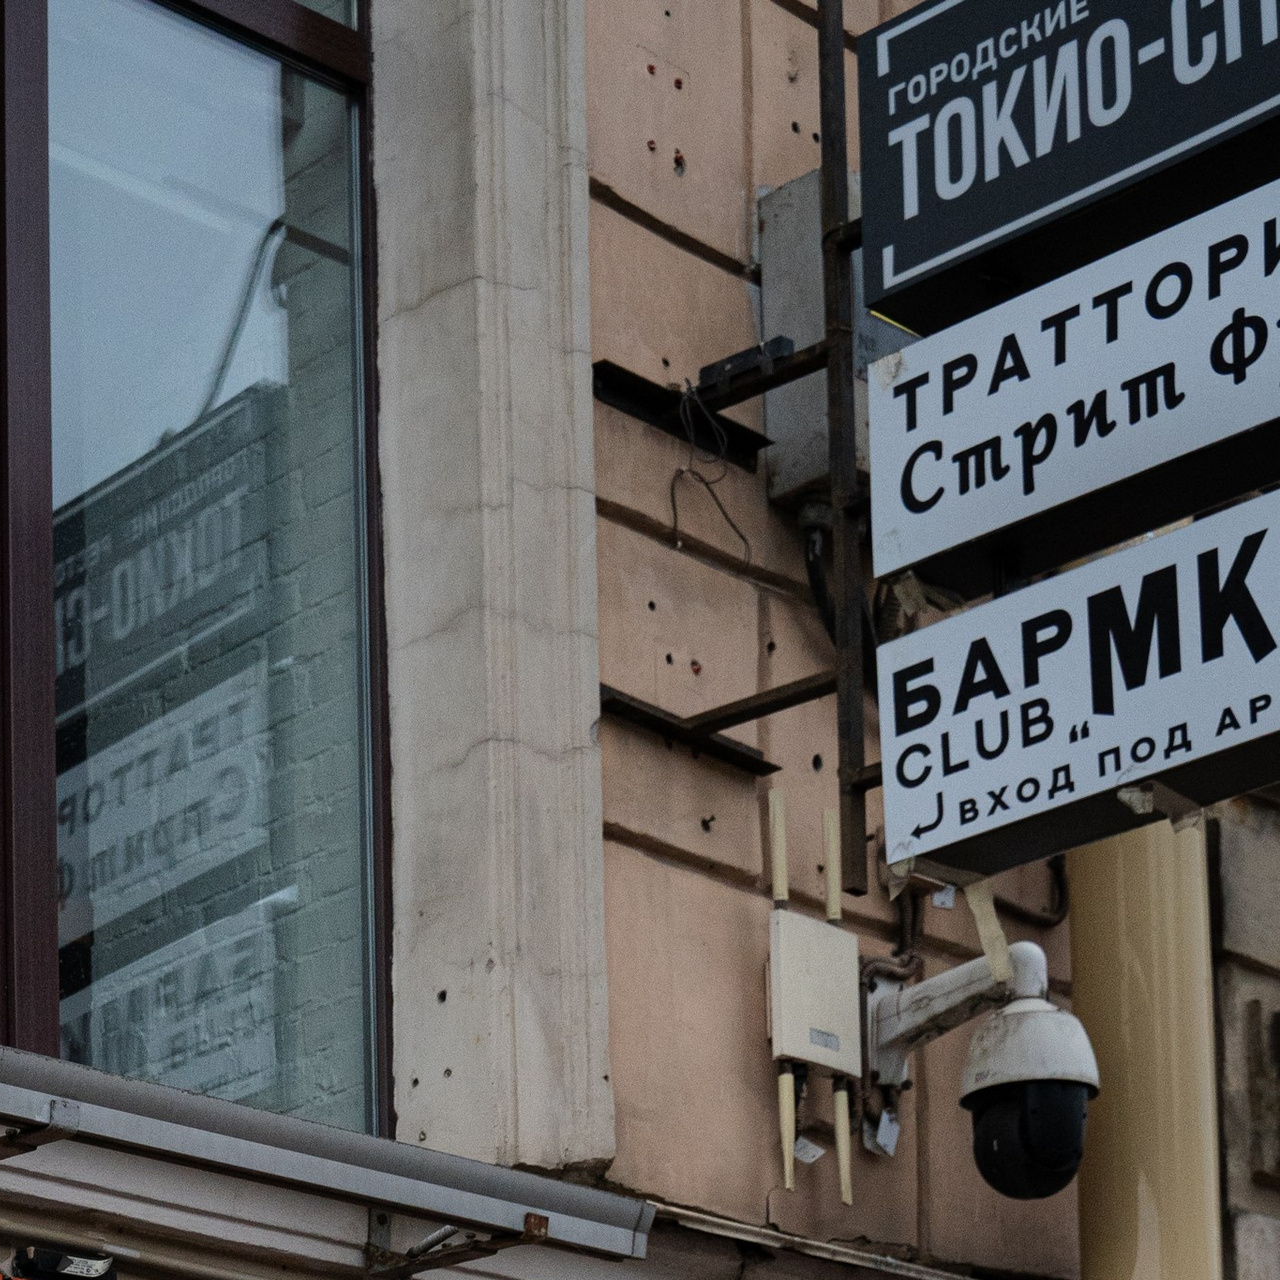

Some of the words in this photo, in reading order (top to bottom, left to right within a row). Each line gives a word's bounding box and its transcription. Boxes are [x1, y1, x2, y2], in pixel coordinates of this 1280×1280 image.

[888, 0, 1090, 116] ГОРОДСКИЕ
[899, 361, 1186, 515] Стрит
[1209, 306, 1280, 387] Ф
[892, 608, 1073, 738] БАР
[896, 697, 1054, 790] CLUB
[959, 763, 1075, 826] ВХОД
[1098, 722, 1192, 778] ПОД
